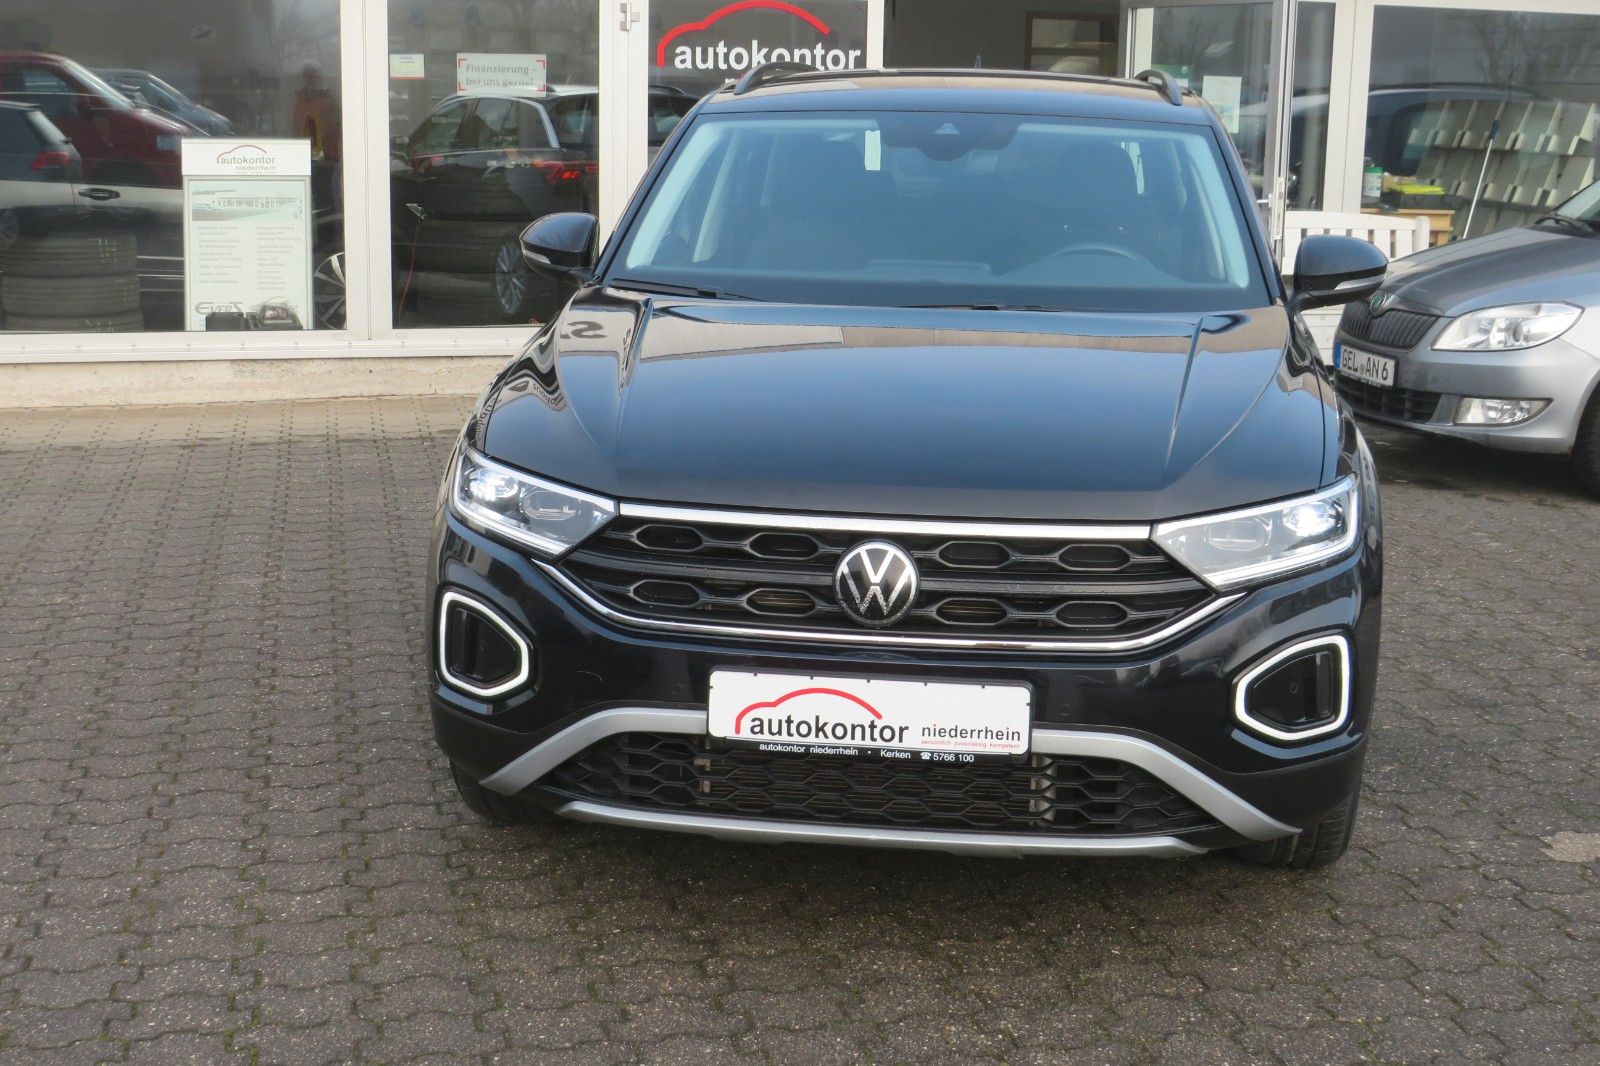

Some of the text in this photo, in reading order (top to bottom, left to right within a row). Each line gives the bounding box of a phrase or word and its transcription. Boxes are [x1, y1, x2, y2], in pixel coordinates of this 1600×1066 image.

[674, 39, 861, 71] autokontor
[466, 63, 529, 76] Finanzierung
[466, 77, 480, 86] bei
[483, 78, 501, 87] uns
[220, 156, 276, 165] autokontor
[1342, 349, 1359, 372] GEL
[1365, 357, 1380, 379] AN
[1381, 361, 1389, 381] 6
[750, 715, 1021, 743] autokontor niederrhein
[759, 743, 975, 762] autokontor niederrhein Kerken 5766 100
